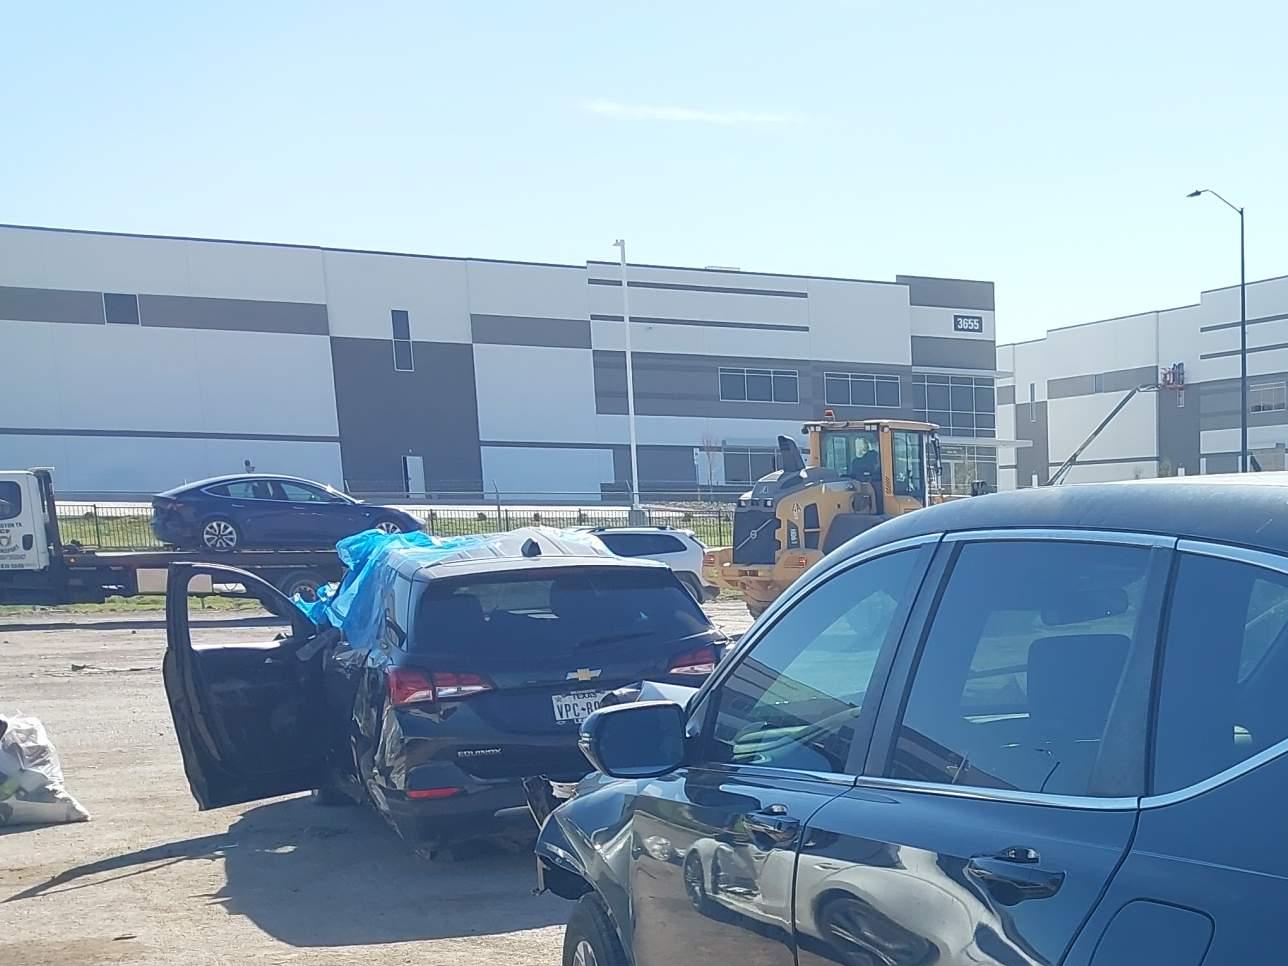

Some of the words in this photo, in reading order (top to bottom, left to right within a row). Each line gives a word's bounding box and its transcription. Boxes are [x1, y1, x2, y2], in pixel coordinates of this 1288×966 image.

[957, 318, 980, 330] 3655
[573, 691, 598, 700] TEXAS
[457, 748, 502, 758] EQUINOX
